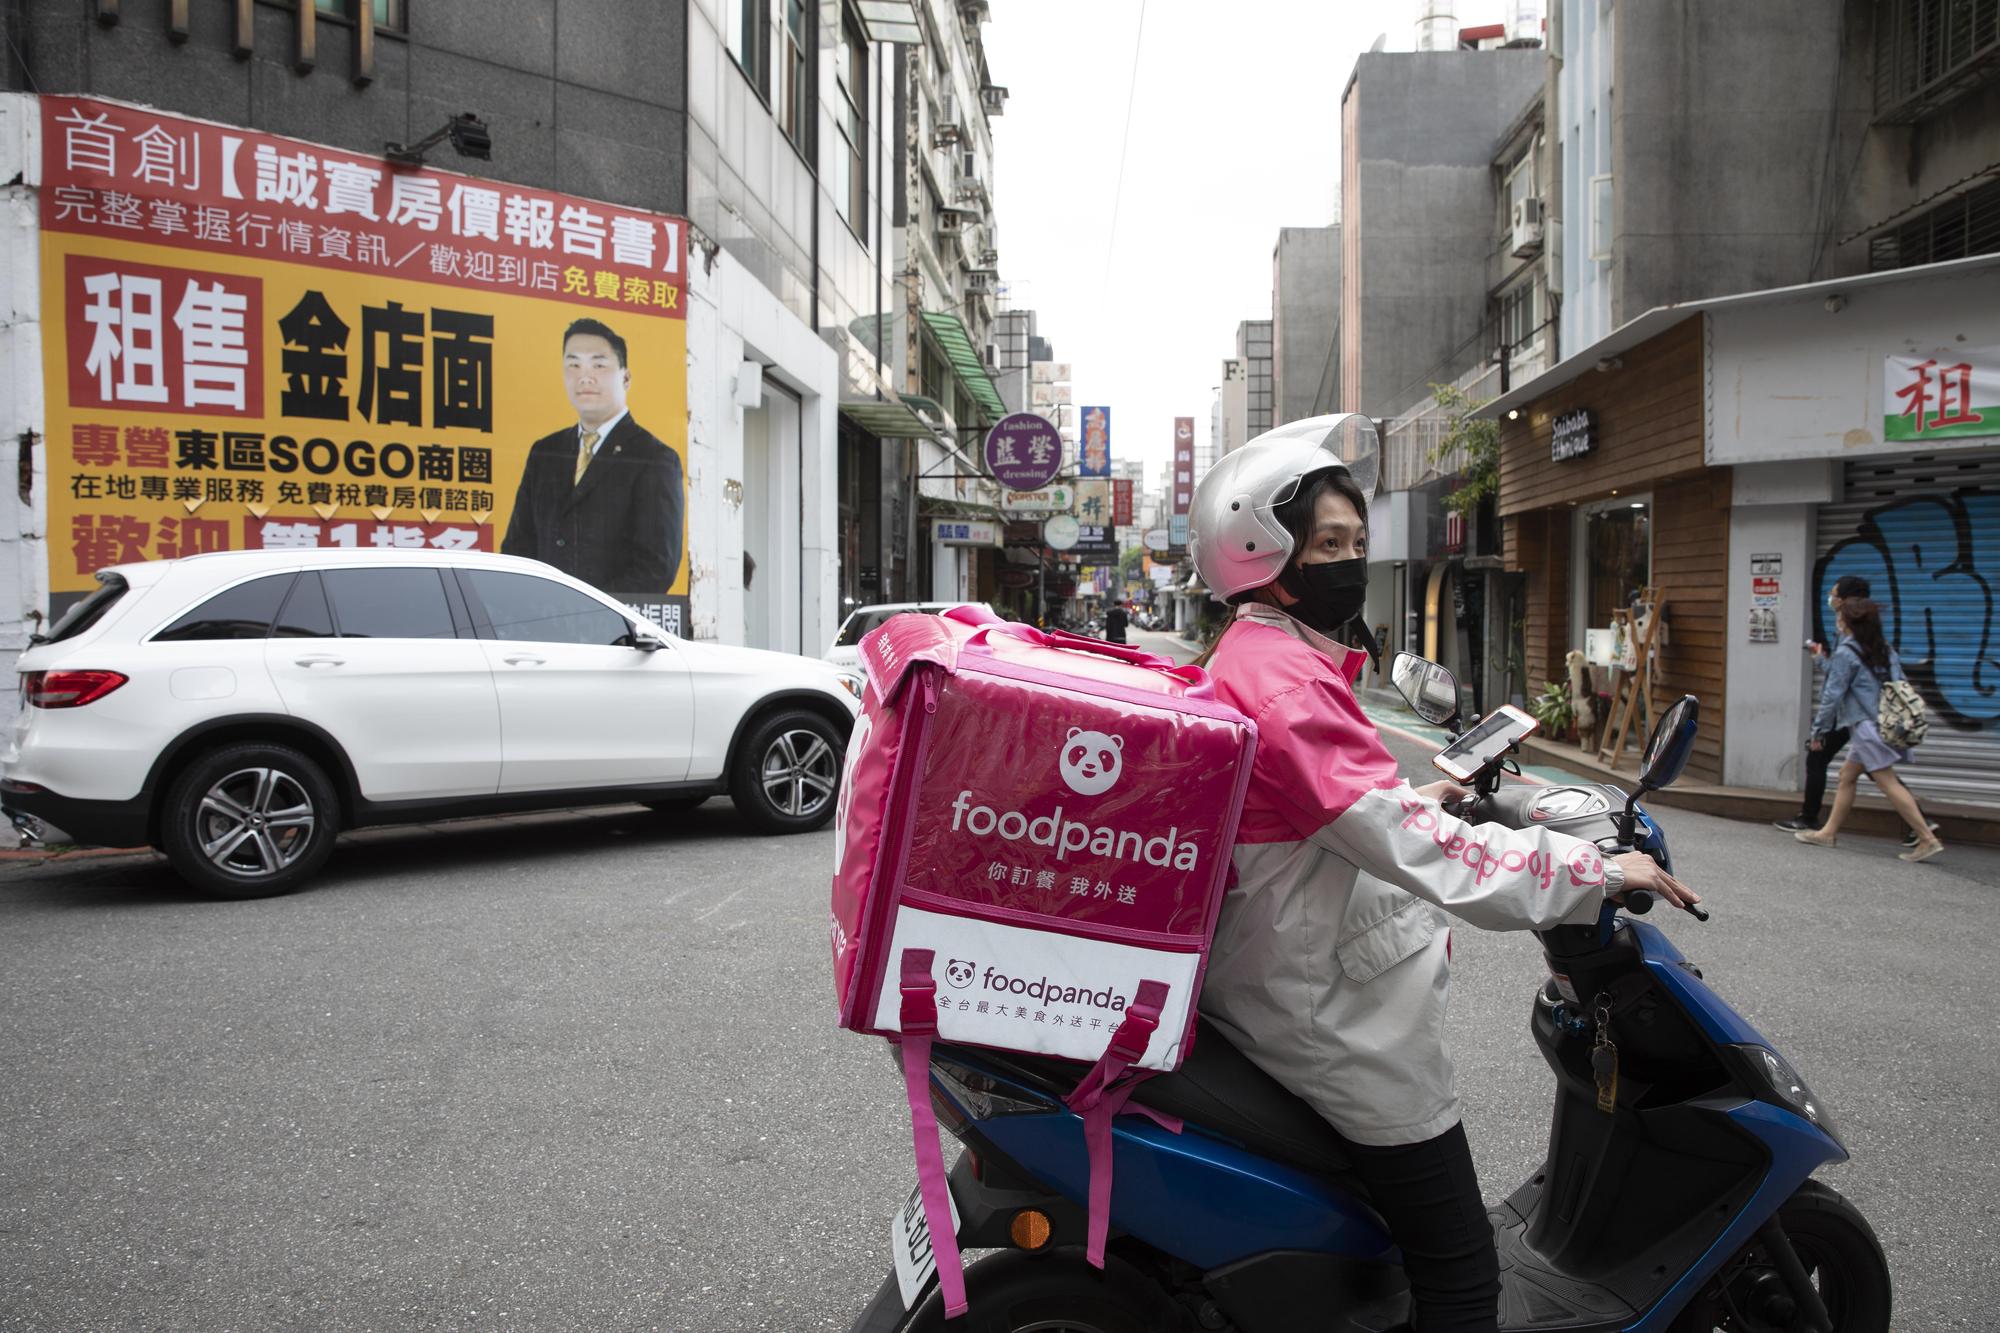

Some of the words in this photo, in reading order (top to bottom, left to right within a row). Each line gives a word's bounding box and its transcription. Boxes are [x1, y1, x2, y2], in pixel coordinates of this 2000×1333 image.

[83, 272, 249, 411] 租售
[277, 289, 495, 434] 金店面
[1895, 358, 1983, 433] 租
[1003, 421, 1043, 431] fashion
[1552, 409, 1589, 439] Saibaba
[72, 423, 492, 484] 專營東區SOGO商圈
[1003, 469, 1048, 479] dressing
[71, 473, 265, 503] 在地專業服務
[951, 790, 1199, 872] foodpanda
[987, 861, 1056, 889] 你訂餐
[1070, 876, 1137, 905] 我外送
[983, 966, 1126, 1012] foodpanda
